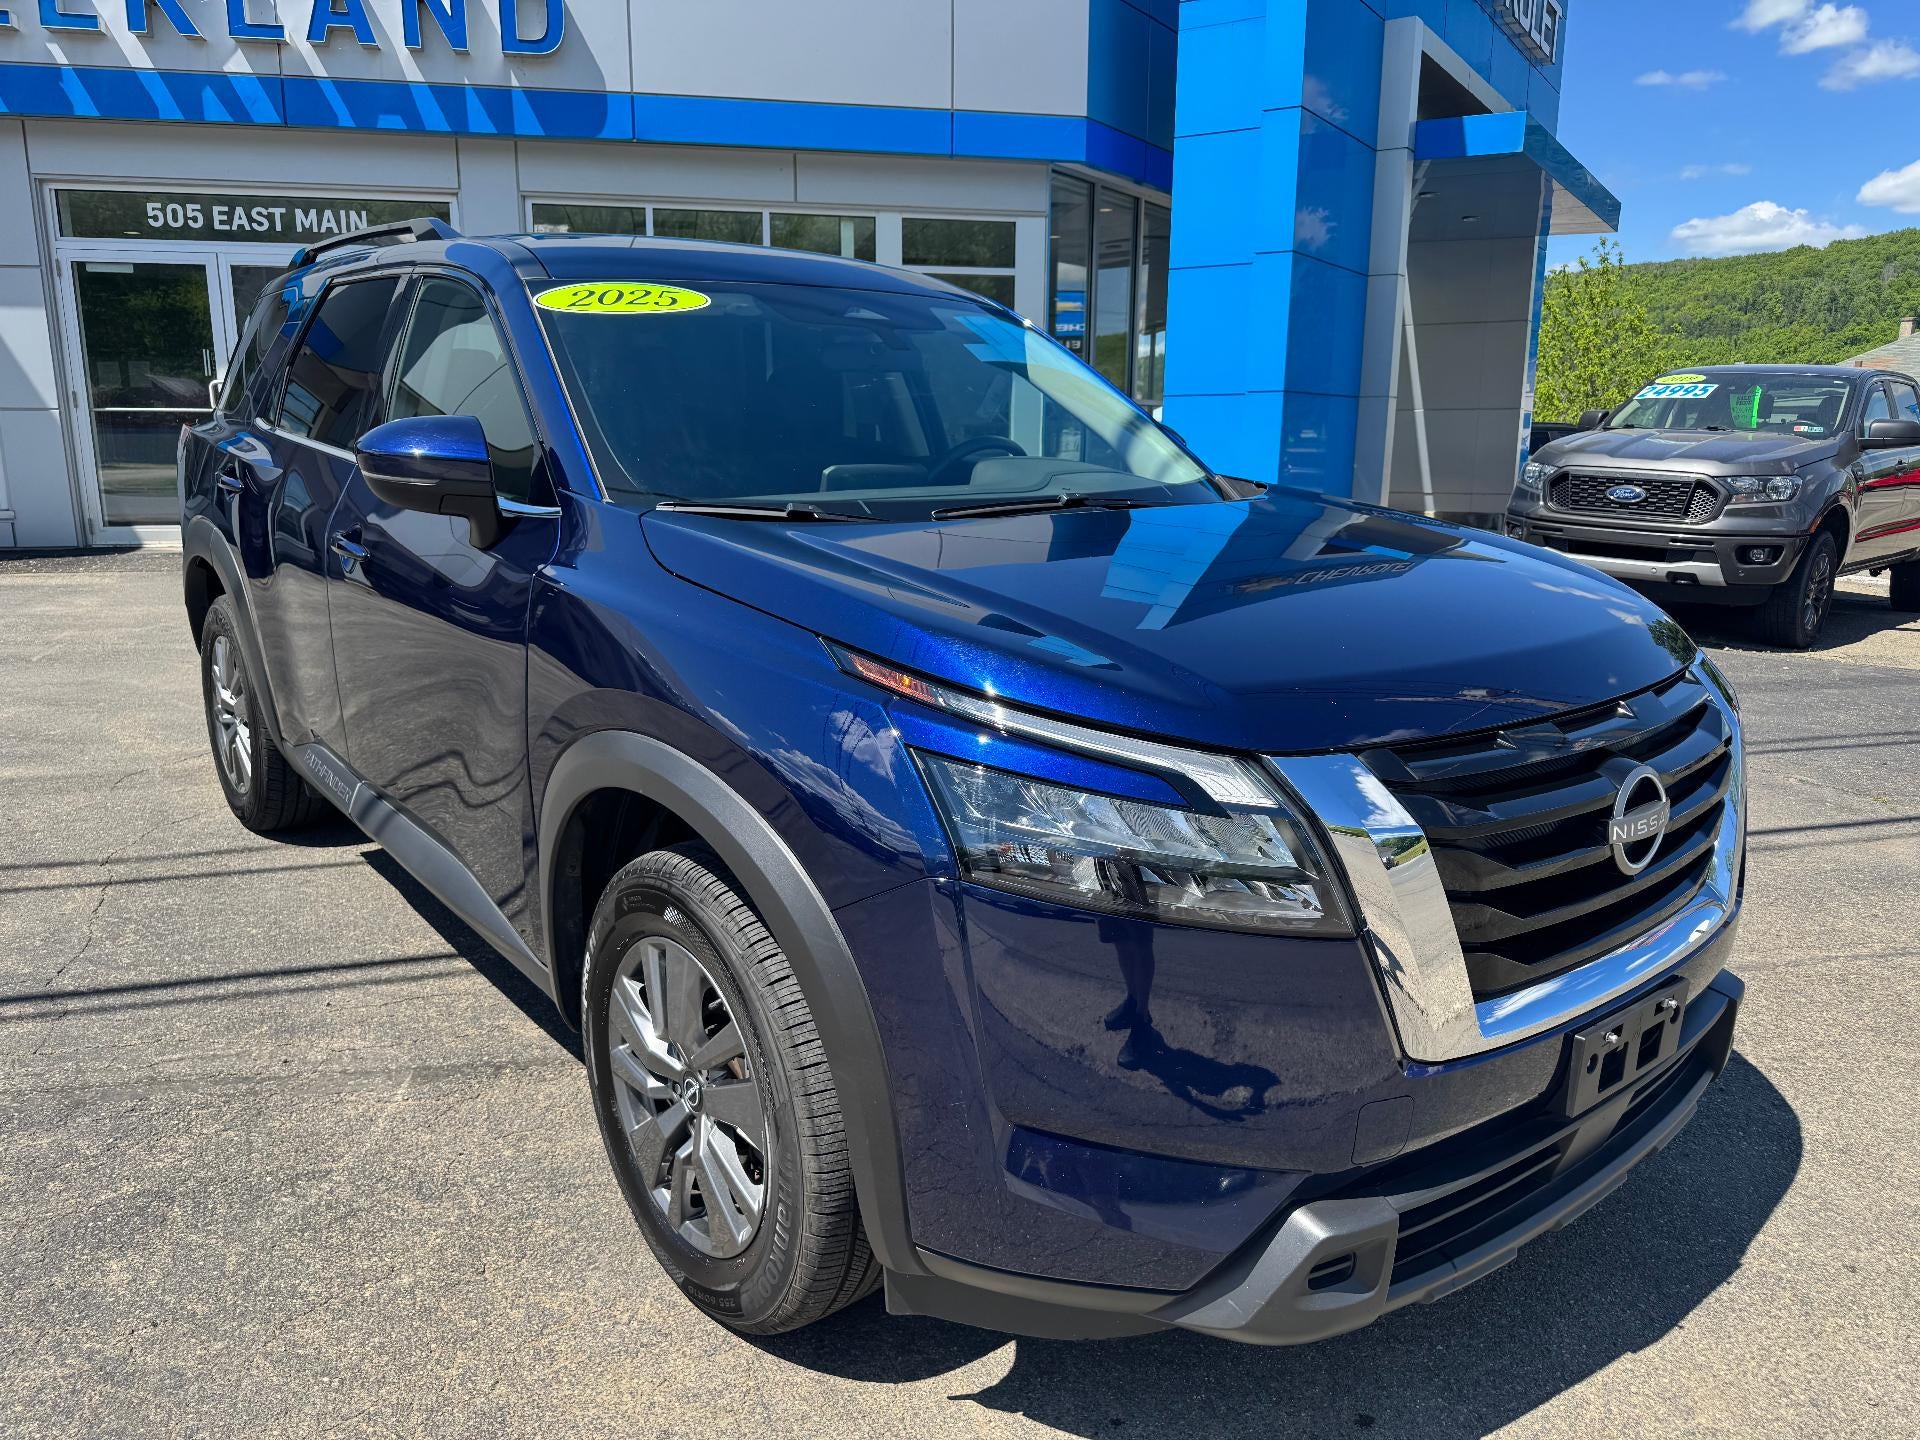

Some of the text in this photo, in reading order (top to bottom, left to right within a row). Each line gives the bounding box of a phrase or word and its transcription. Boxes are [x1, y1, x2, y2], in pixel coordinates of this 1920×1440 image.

[146, 202, 368, 233] 505 EAST MAIN
[567, 289, 680, 307] 2025
[1637, 384, 1714, 399] 24995
[304, 749, 352, 804] PATHFINDER
[1612, 807, 1670, 841] NISSA
